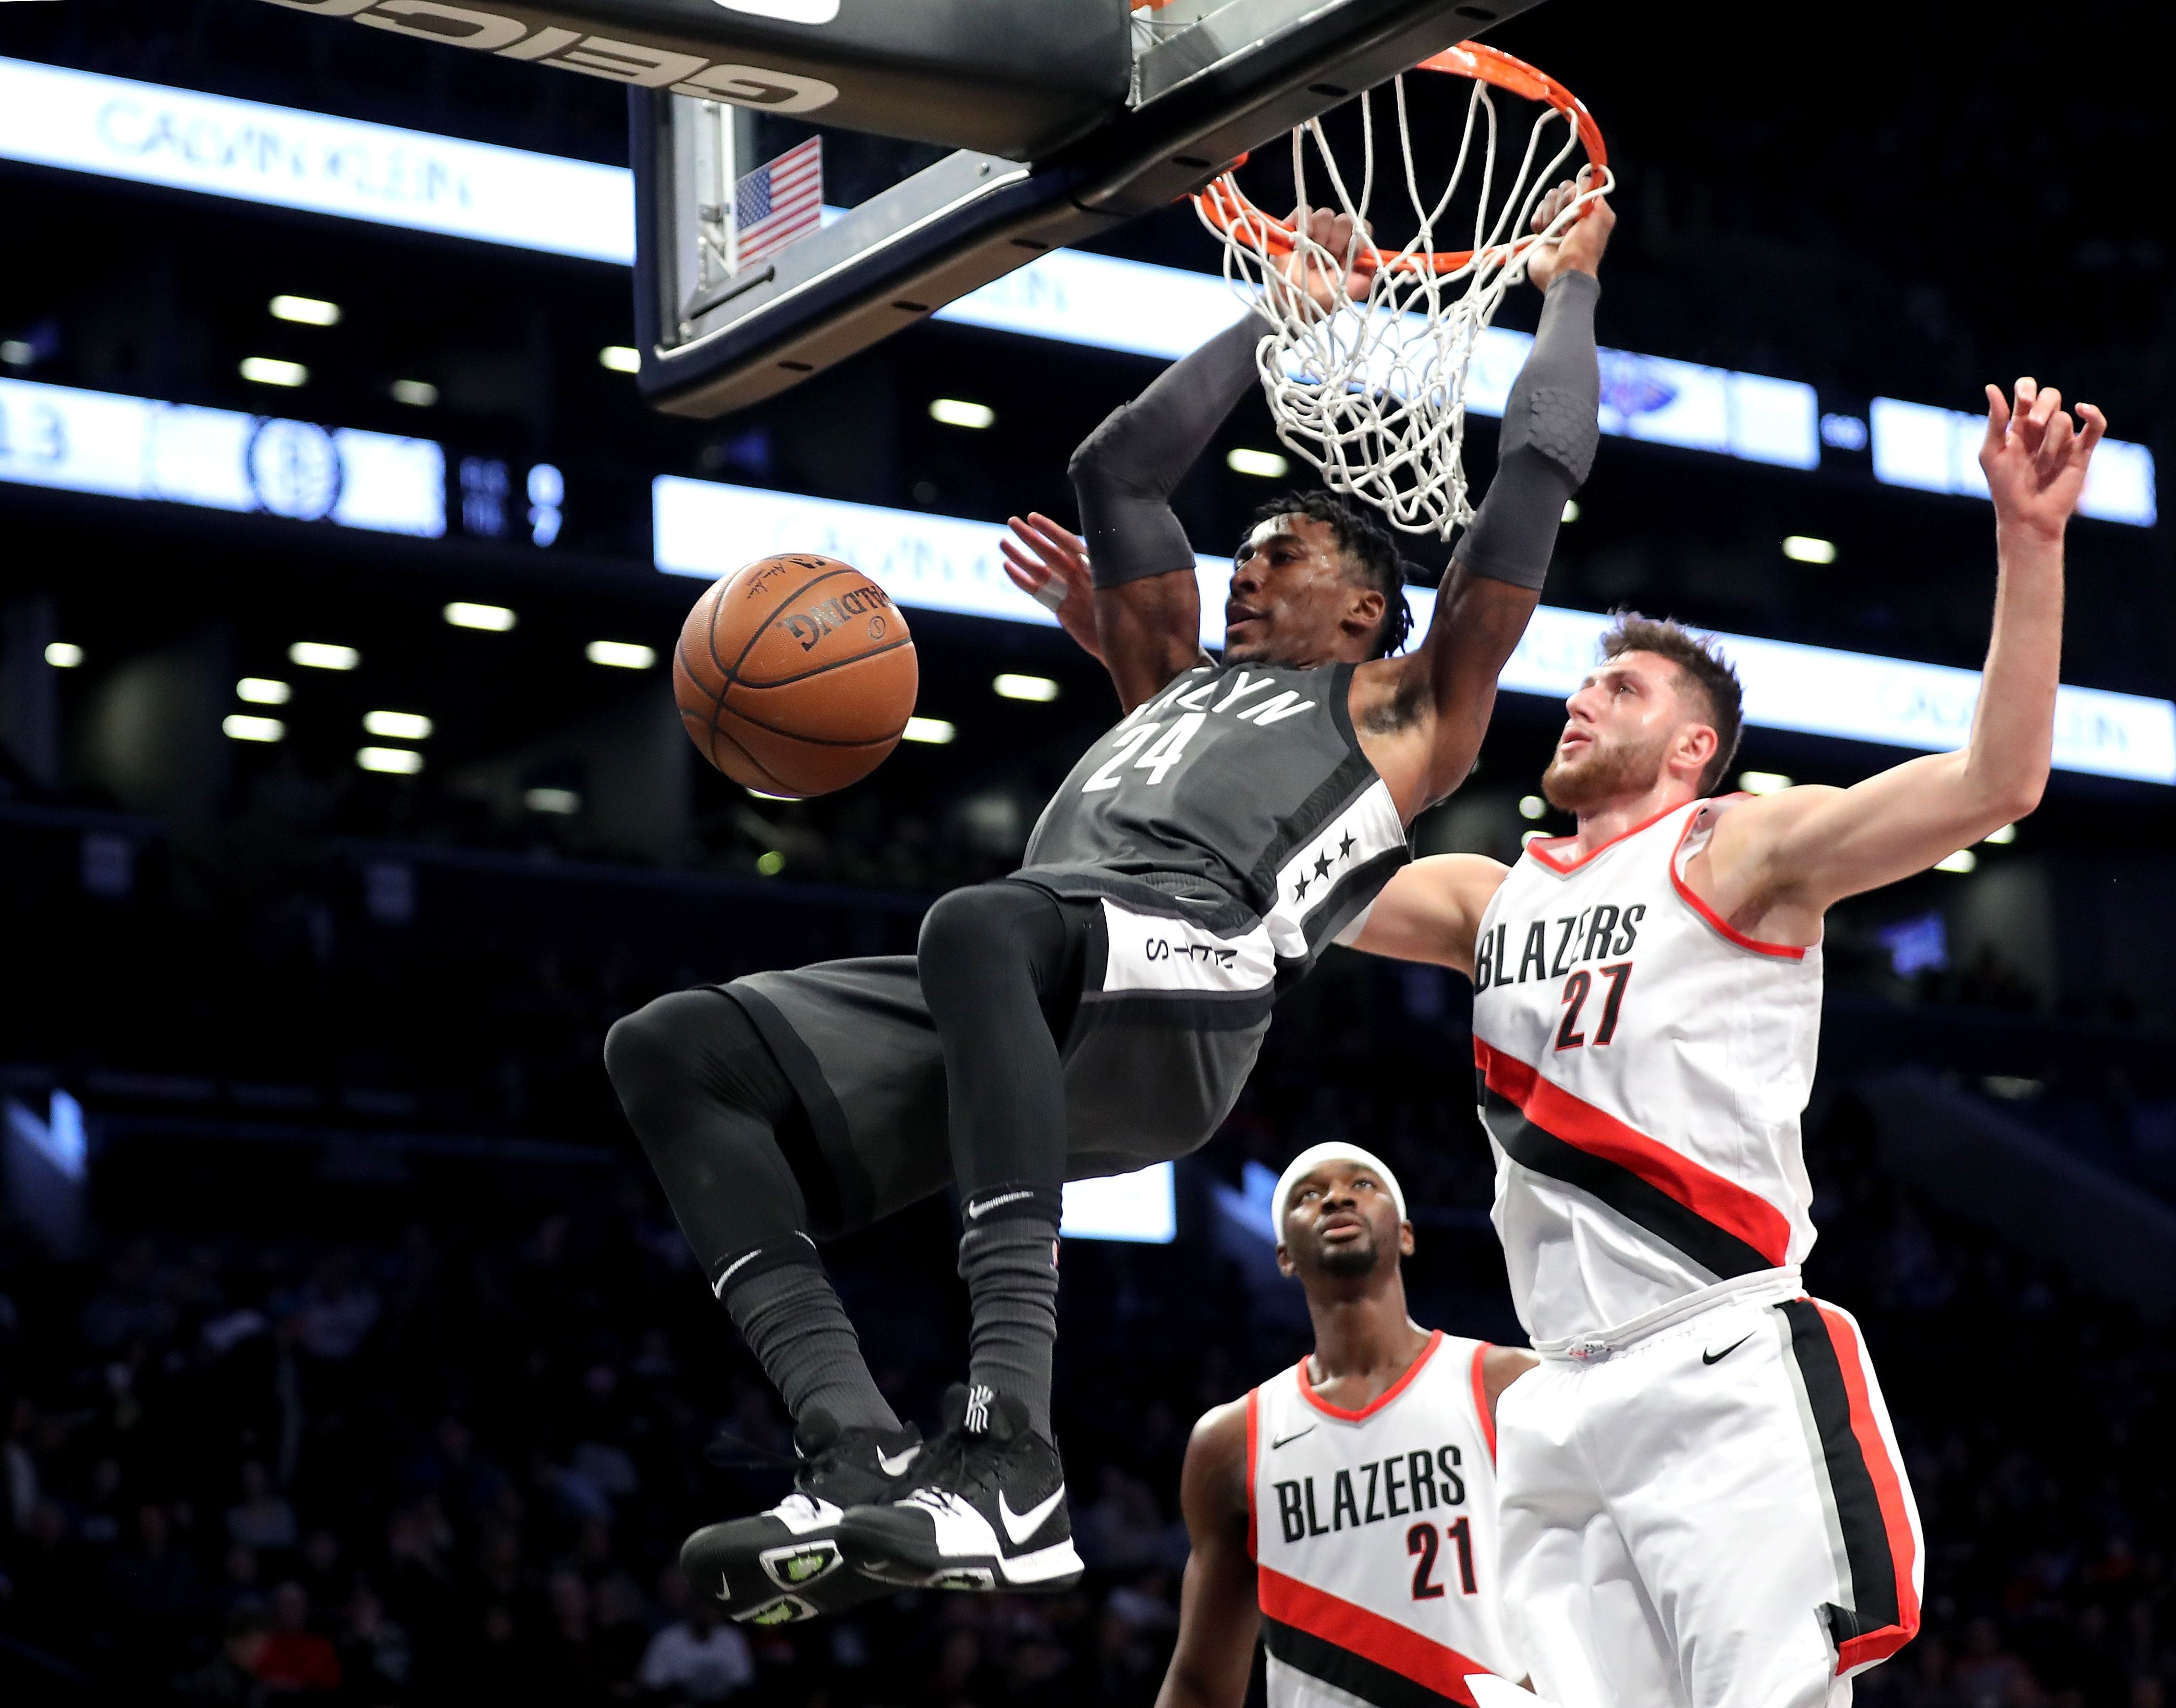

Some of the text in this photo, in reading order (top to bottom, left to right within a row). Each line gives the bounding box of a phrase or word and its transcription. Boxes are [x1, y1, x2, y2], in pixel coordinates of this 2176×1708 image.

[259, 0, 838, 114] GEIC
[1081, 712, 1206, 793] 24
[1555, 961, 1633, 1051] 27
[1272, 1444, 1466, 1543] BLAZERS
[1406, 1516, 1478, 1601] 21
